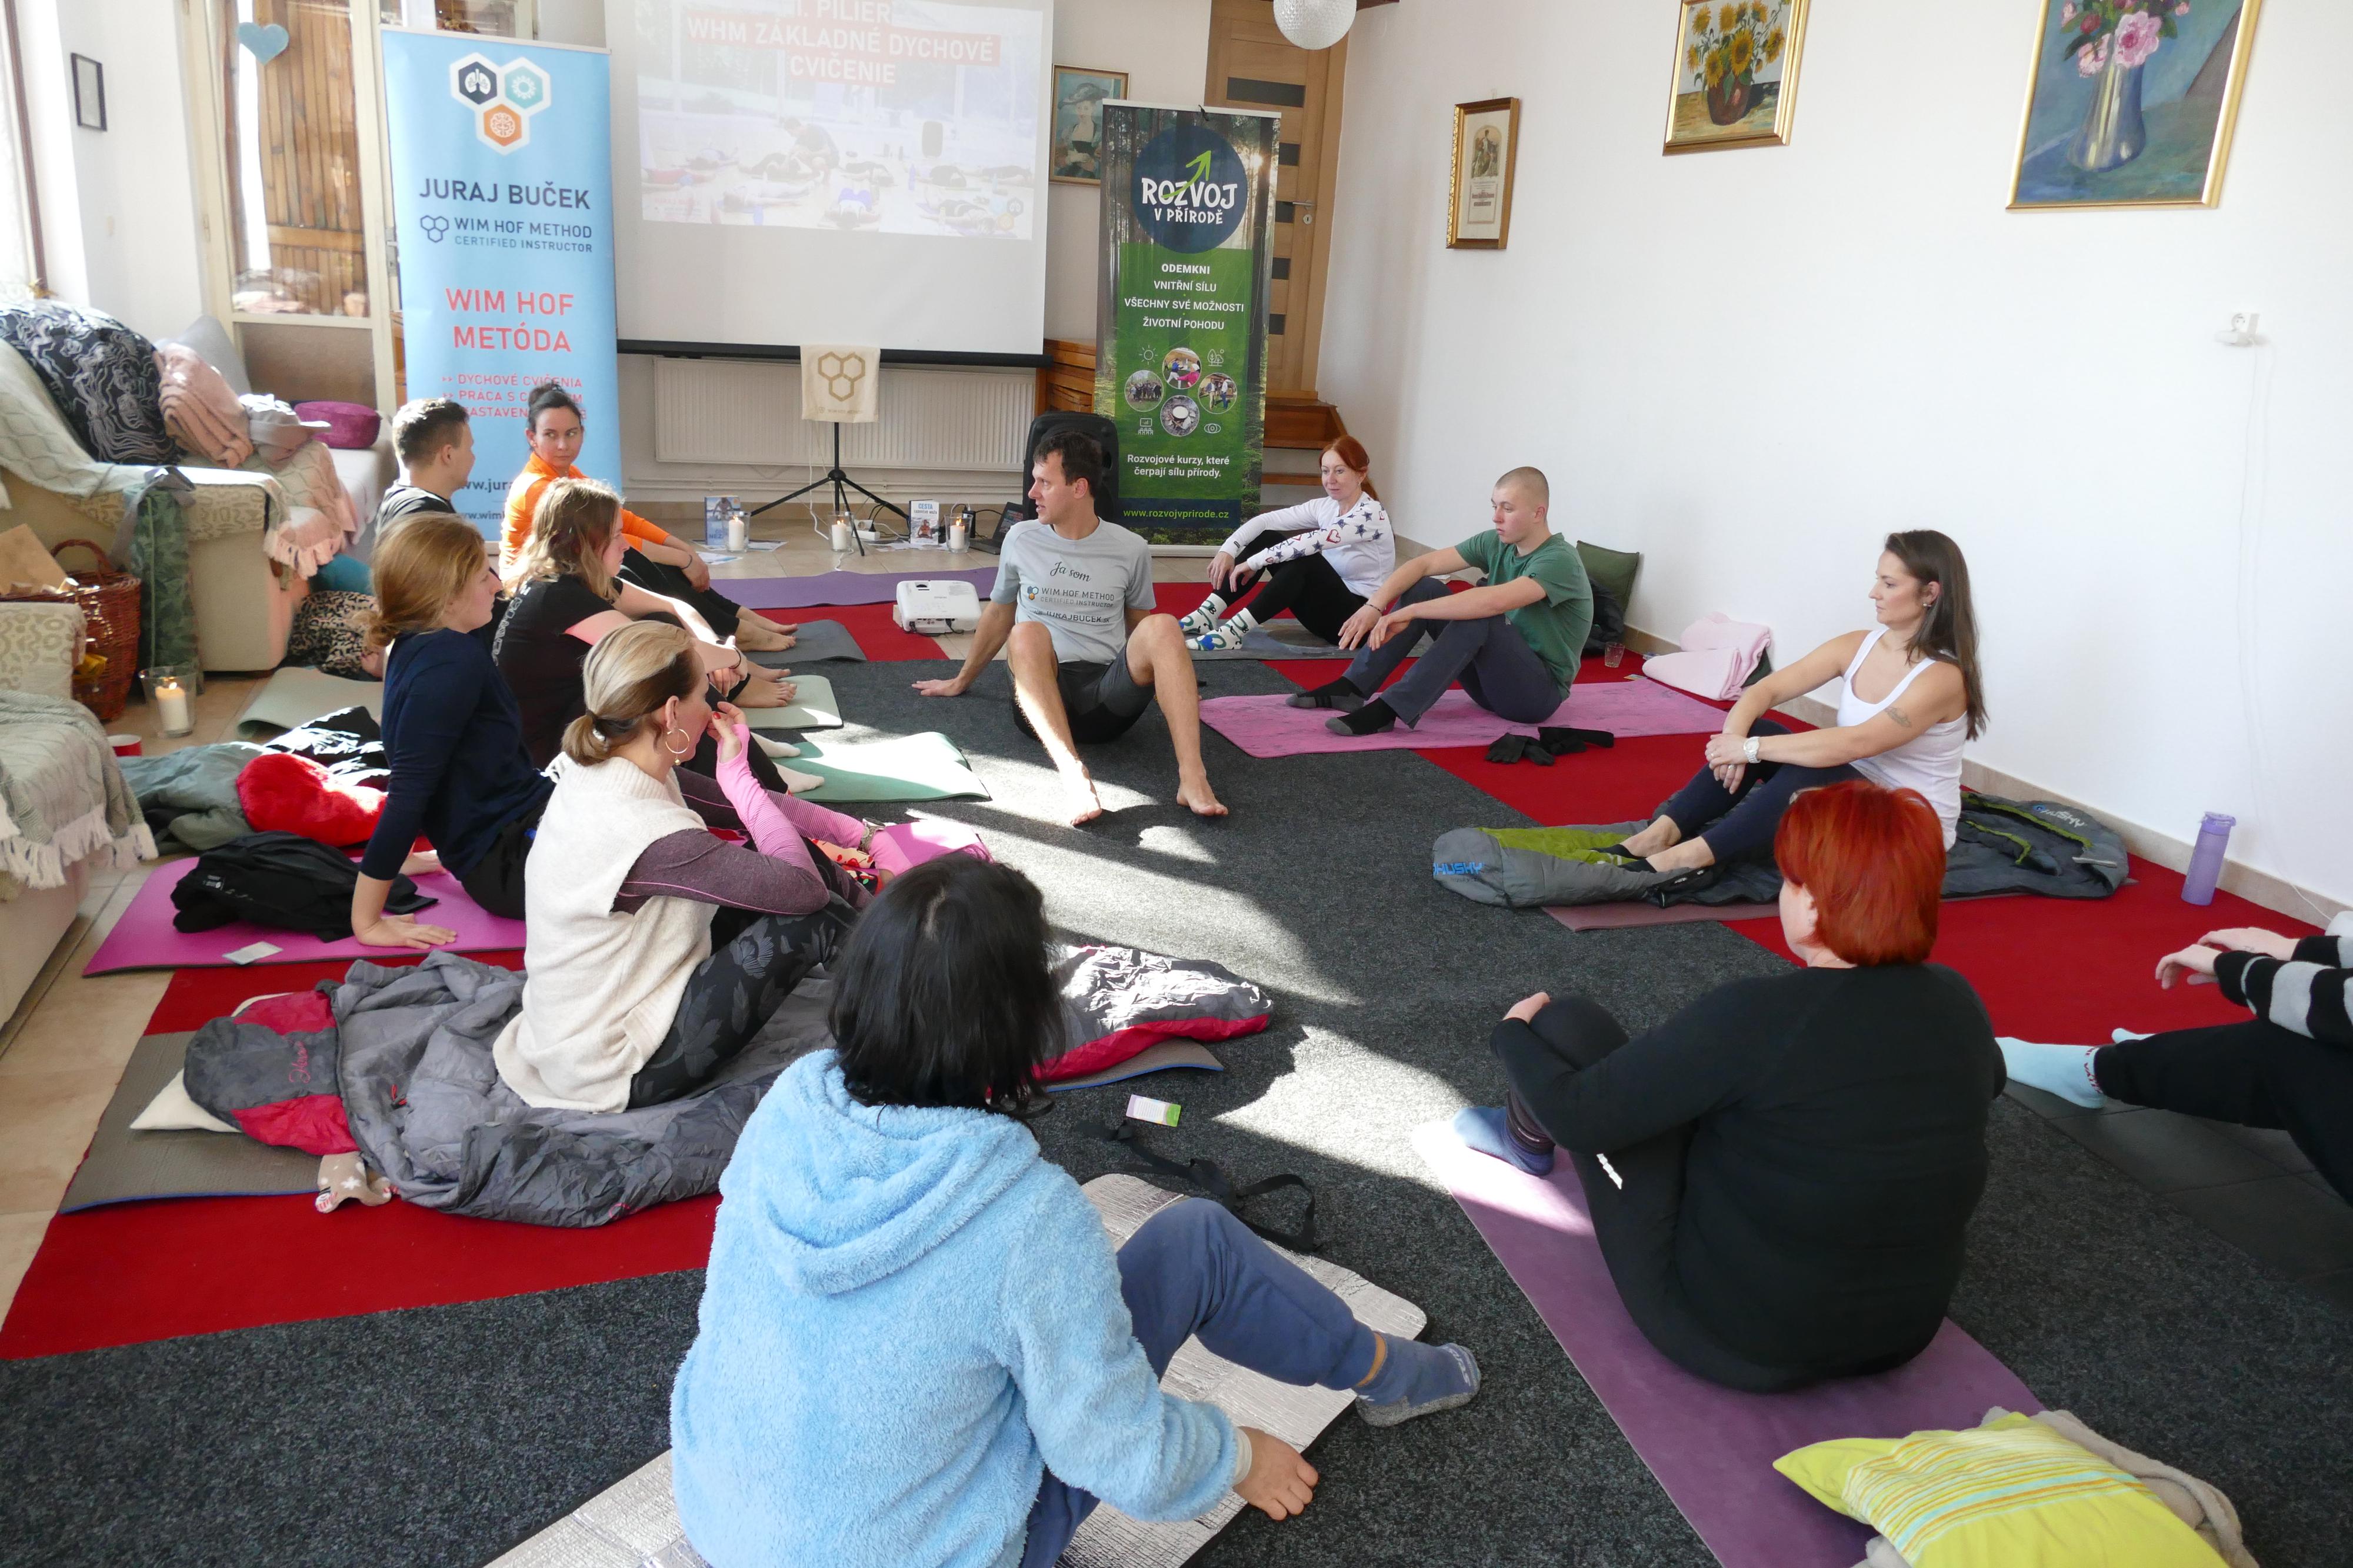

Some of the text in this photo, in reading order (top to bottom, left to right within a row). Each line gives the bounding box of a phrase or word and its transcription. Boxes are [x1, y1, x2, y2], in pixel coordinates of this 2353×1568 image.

[816, 0, 890, 24] PILIER
[688, 18, 994, 63] WHM ZÁKLADNÉ DYCHOVÉ
[790, 52, 896, 84] CVIČENIE
[419, 178, 591, 209] JURAJ BUČEK
[1141, 178, 1238, 209] ROZVOJ
[1154, 206, 1224, 225] V PŘÍRODĚ
[455, 218, 592, 238] WIM HOF METHOD
[455, 236, 592, 253] CERTIFIED INSTRUCTOR
[1161, 263, 1210, 275] ODEMKNI
[1154, 279, 1217, 292] VNITŘNÍ SÍLU
[445, 288, 574, 315] WIM HOF
[1125, 296, 1244, 312] VŠECHNY SVÉ MOŽNOSTI
[1142, 315, 1224, 329] ŽIVOTNÍ POHODU
[454, 322, 572, 352] METÓDA
[458, 373, 518, 386] DYCHOVÉ
[459, 388, 502, 401] PRÁCA
[508, 392, 515, 402] S
[1127, 454, 1230, 468] Rozvojové kurzy, které
[1134, 466, 1221, 479] čerpají sílu přírody.
[1124, 509, 1229, 519] www.rozvojvprirode.cz
[1050, 561, 1091, 582] Ja som
[1040, 596, 1114, 608] CERTIFIED INSTRUCTOR
[1082, 592, 1115, 601] METHOD
[1437, 862, 1483, 875] HUSKY
